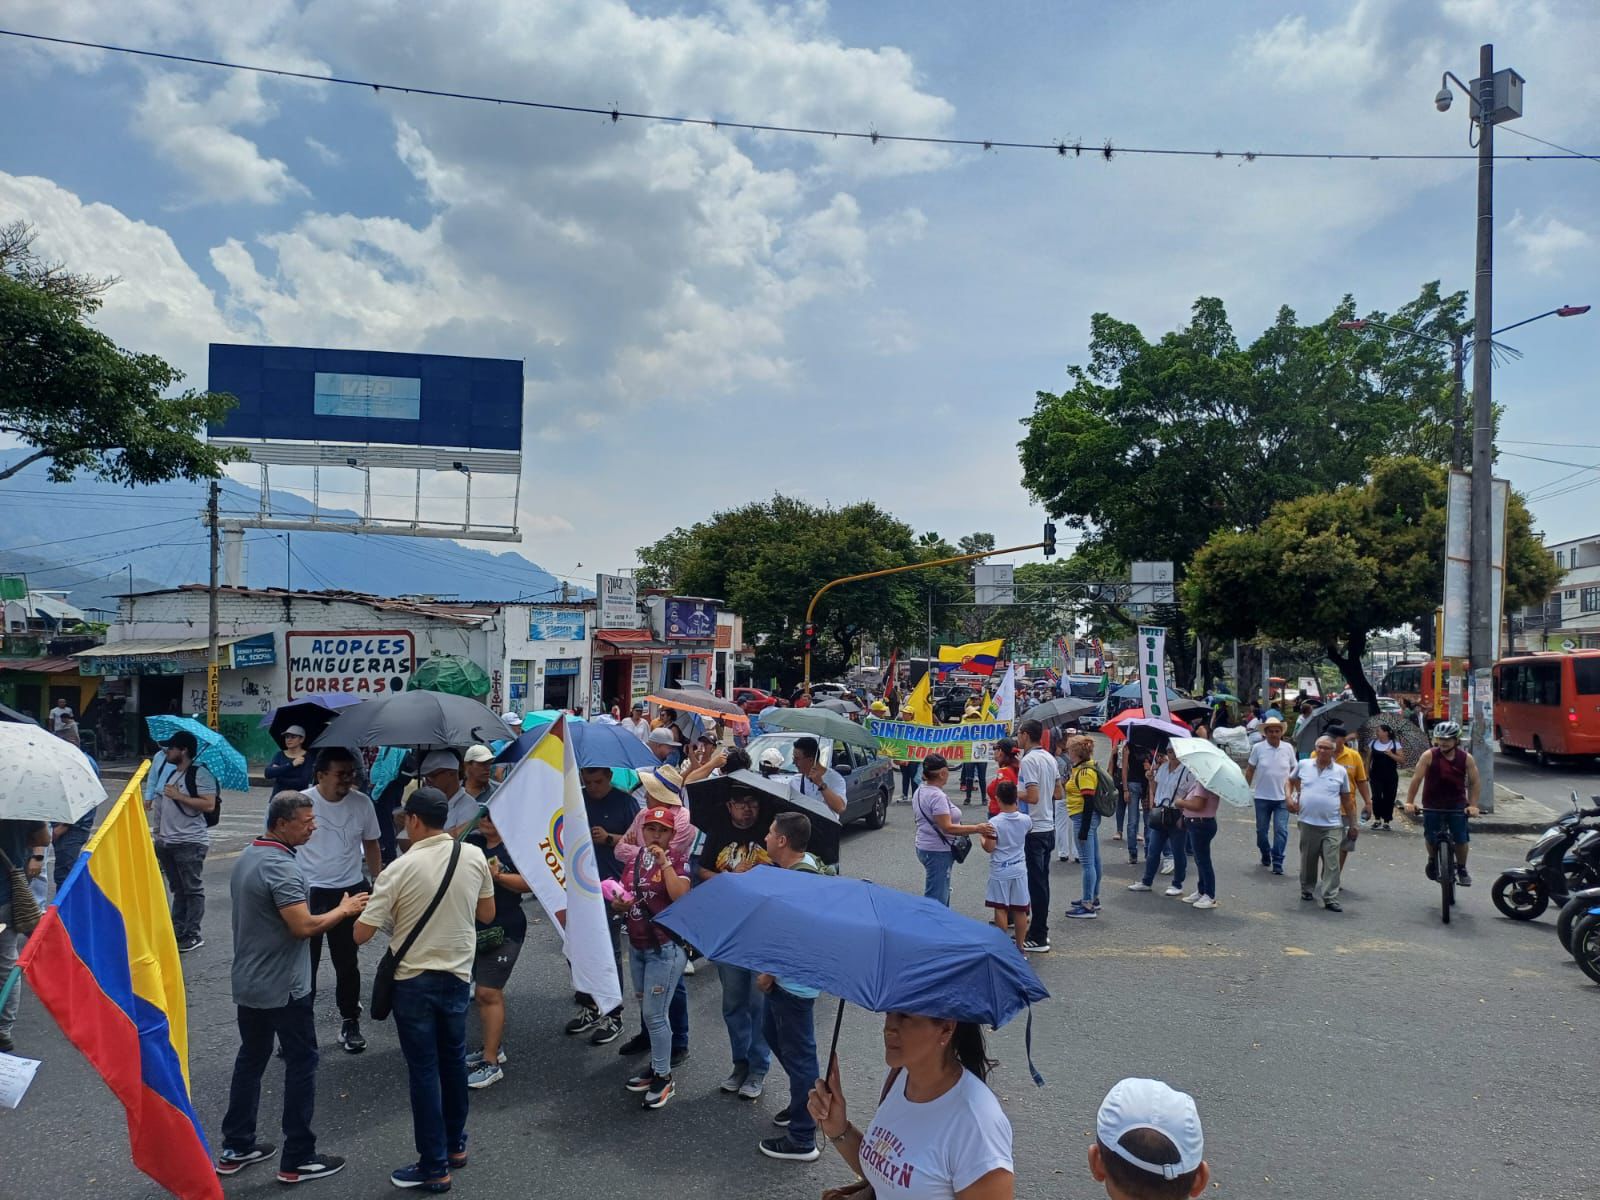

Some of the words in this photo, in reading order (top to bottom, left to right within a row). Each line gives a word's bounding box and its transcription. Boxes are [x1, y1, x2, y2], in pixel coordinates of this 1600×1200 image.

[312, 639, 405, 655] ACOPLES
[290, 657, 410, 673] MANGUERAS
[1146, 637, 1161, 719] SIMATO
[210, 666, 218, 727] TAPICERIA
[294, 676, 386, 692] CORREAS
[870, 720, 1007, 743] SINTRAEDUCACION
[872, 1126, 905, 1158] ORIGINAL
[860, 1138, 914, 1189] ROOKLYN
